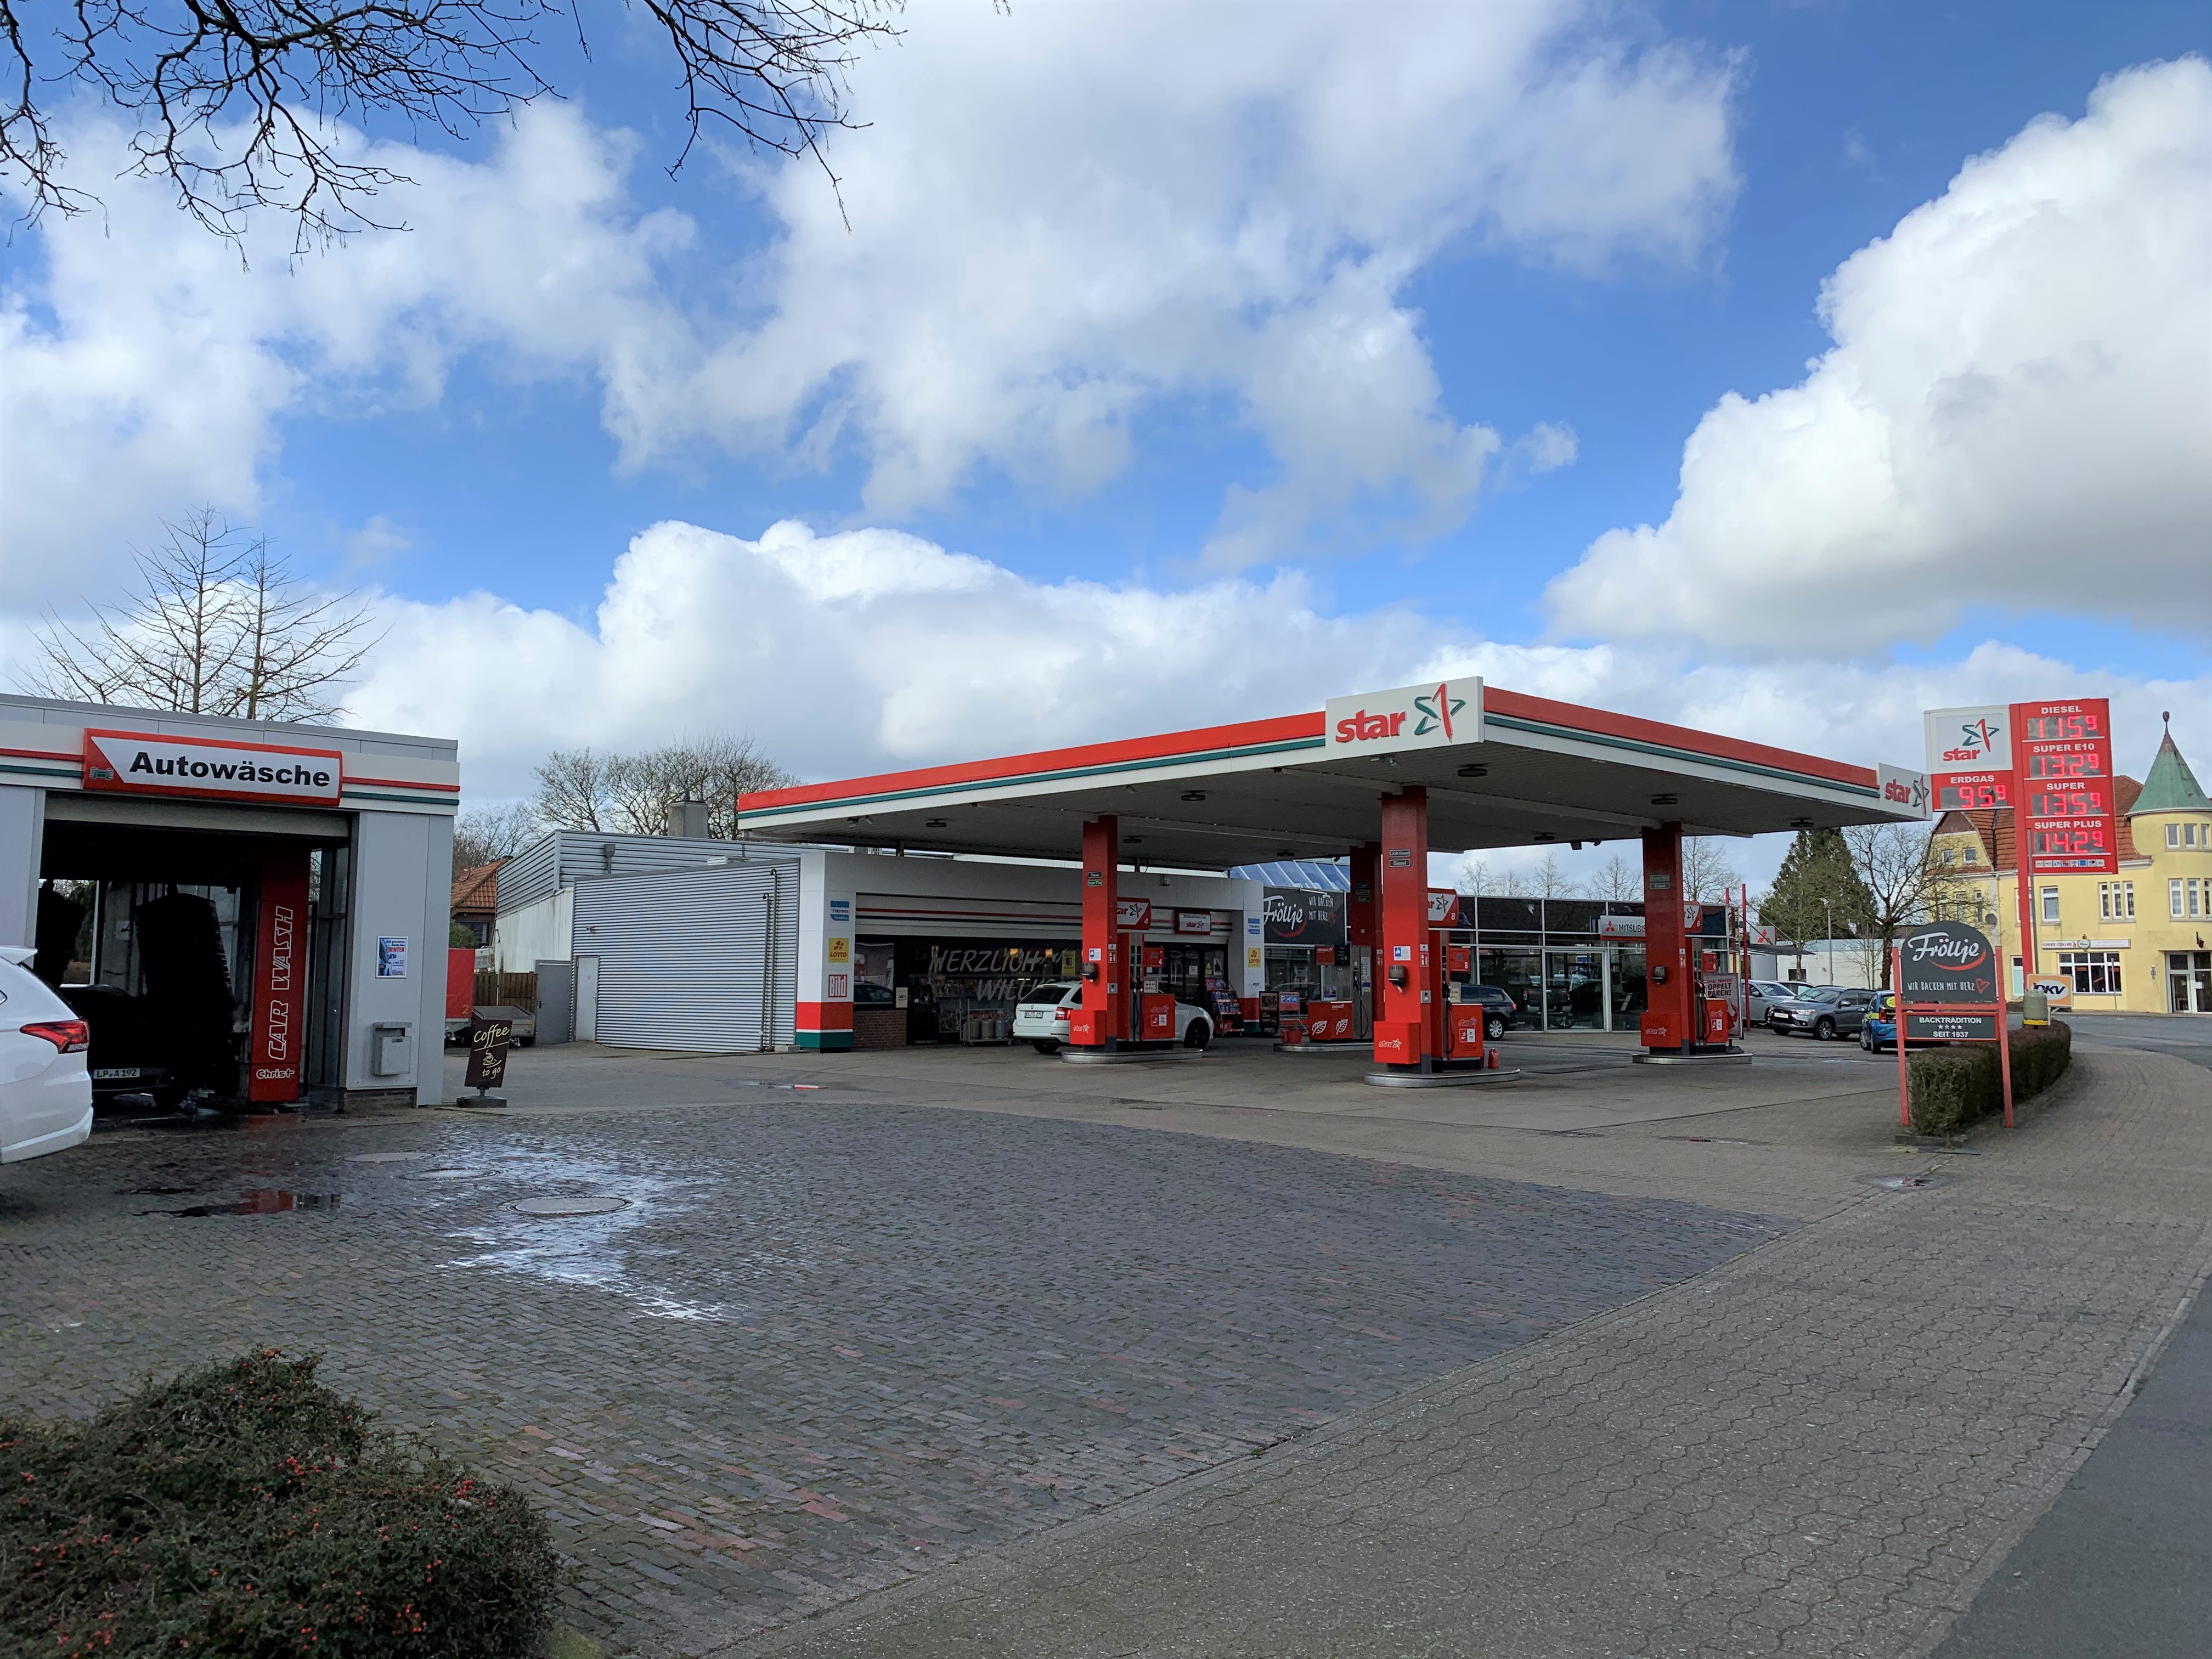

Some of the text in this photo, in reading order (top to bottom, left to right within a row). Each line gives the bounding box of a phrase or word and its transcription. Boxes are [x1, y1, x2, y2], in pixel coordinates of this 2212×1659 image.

[2041, 705, 2083, 714] DIESEL
[1335, 709, 1407, 743] star
[2033, 743, 2095, 753] SUPER E10
[1942, 747, 1980, 761] star
[129, 751, 330, 787] Autowäsche
[1950, 775, 1995, 784] ERDGAS
[1884, 778, 1911, 804] star
[2046, 782, 2085, 791] SUPER
[2034, 821, 2071, 829] SUPER
[1308, 896, 1317, 906] WIR
[1263, 895, 1303, 930] Fröllje
[1318, 910, 1328, 921] HERZ
[1908, 932, 1979, 964] Fröllje
[268, 905, 294, 1060] CAR WASH
[830, 975, 847, 997] Bild
[1707, 982, 1732, 990] OPPELT
[1907, 981, 1975, 991] WIR BACKEN MIT HERZ
[1379, 1040, 1392, 1048] star
[121, 1069, 136, 1077] 192
[256, 1067, 295, 1079] Christ
[482, 1066, 501, 1079] to go
